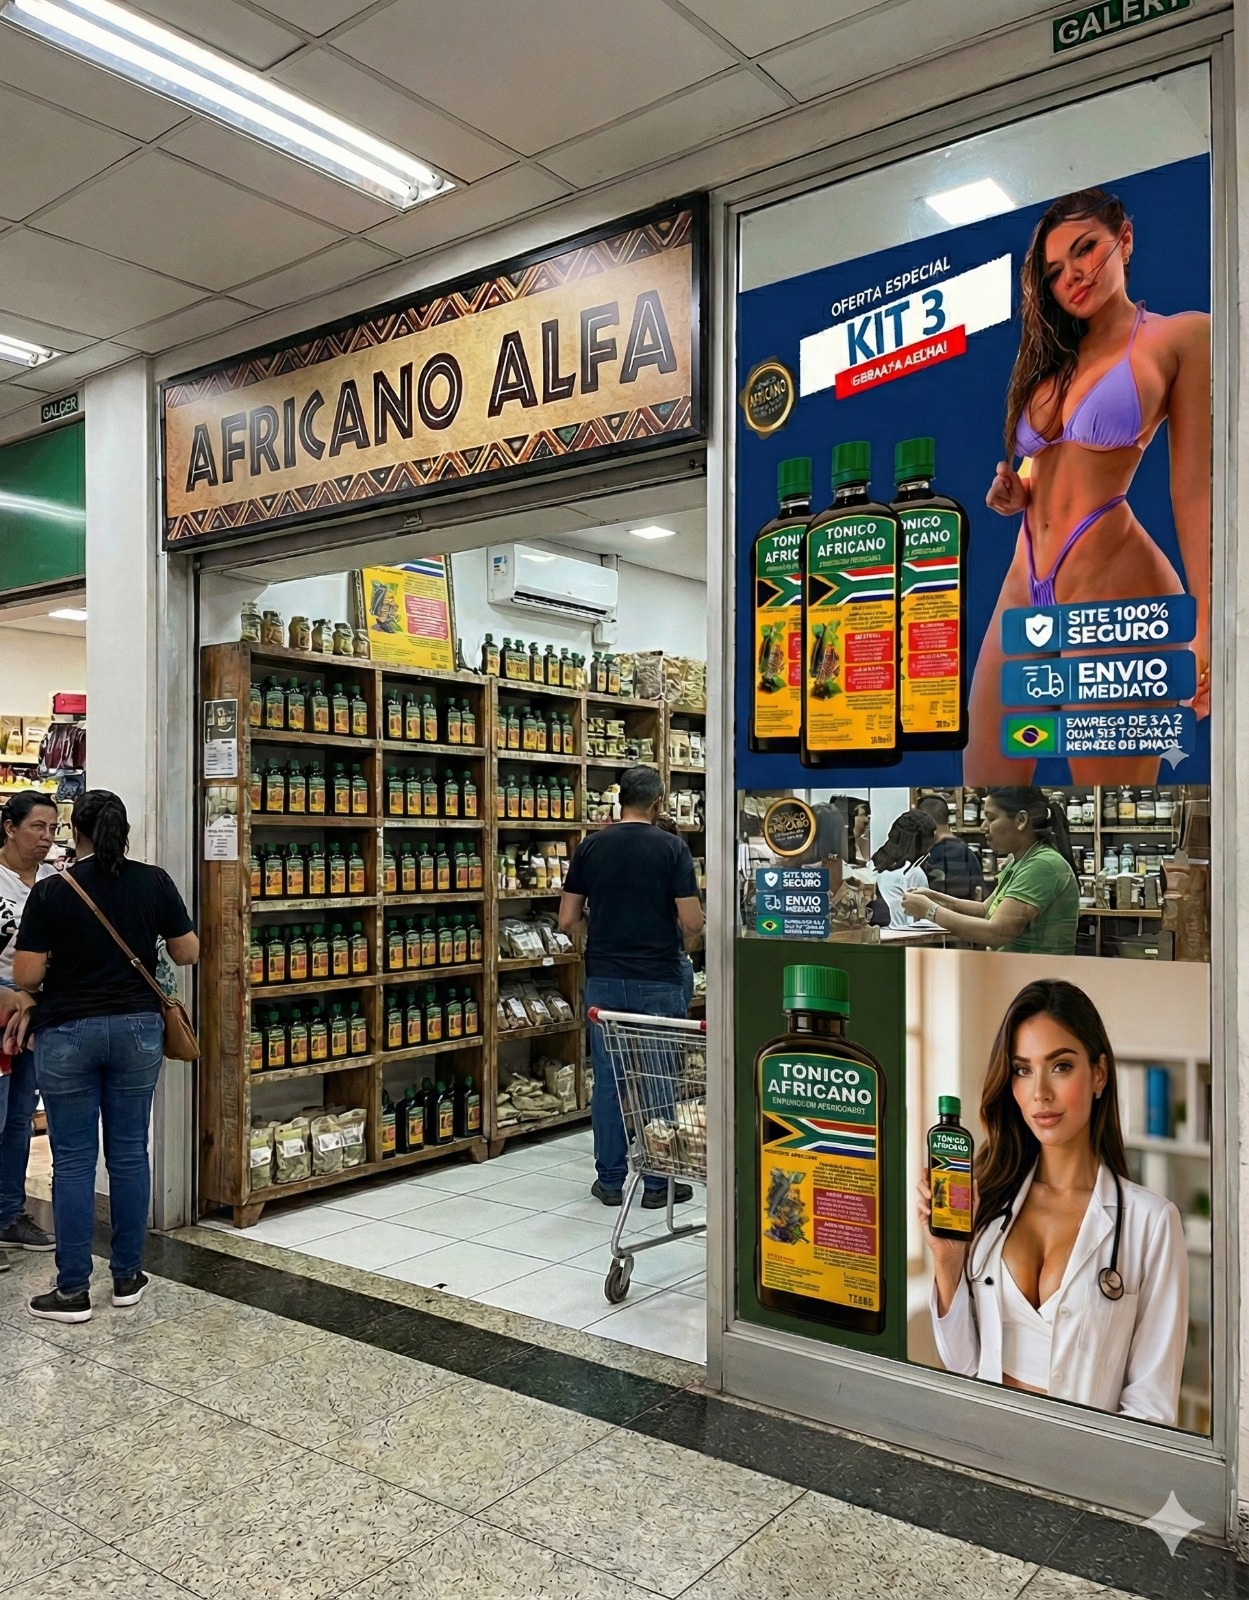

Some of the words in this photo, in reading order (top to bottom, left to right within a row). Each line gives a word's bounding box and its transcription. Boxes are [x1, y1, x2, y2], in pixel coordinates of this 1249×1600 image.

[831, 286, 882, 317] OFERTA
[885, 256, 951, 295] ESPECIAL
[847, 300, 910, 367] KIT
[921, 289, 946, 336] 3
[185, 352, 463, 493] AFRICANO
[487, 289, 677, 418] ALFA
[772, 533, 804, 548] TONI
[817, 537, 886, 558] AFRICANO
[1067, 607, 1110, 625] SITE
[1113, 602, 1169, 621] 100%
[1067, 620, 1169, 645] SEGURO
[1078, 658, 1168, 684] ENVIO
[1078, 681, 1168, 700] IMEDIATO
[1128, 714, 1148, 727] DE
[785, 895, 821, 906] ENVIO
[767, 1079, 872, 1105] AFRICANO
